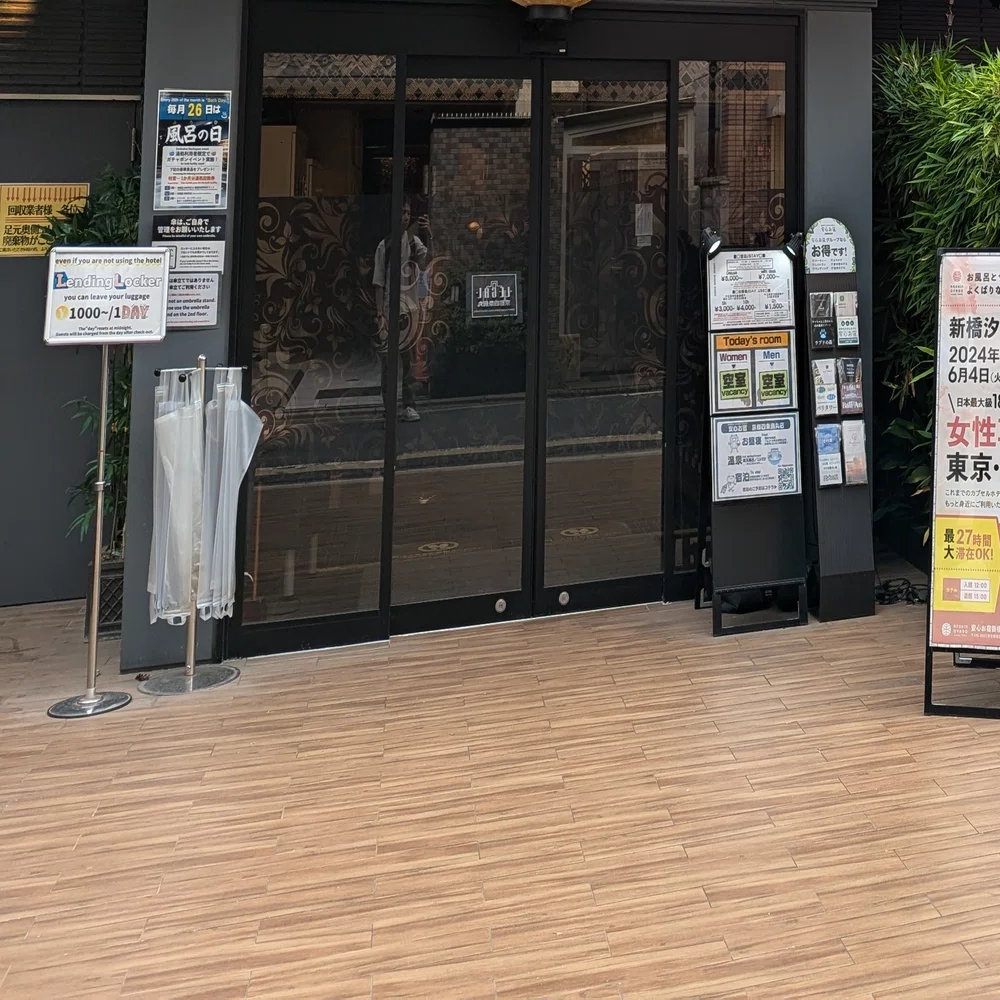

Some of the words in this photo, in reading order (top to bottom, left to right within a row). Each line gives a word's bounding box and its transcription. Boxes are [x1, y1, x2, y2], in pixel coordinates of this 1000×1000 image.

[165, 124, 222, 144] 風呂の日
[8, 204, 53, 216] 回収業者様
[811, 244, 848, 257] お得です!
[78, 258, 90, 266] you
[116, 256, 133, 266] using
[134, 256, 144, 264] the
[145, 256, 162, 264] hotel
[125, 293, 150, 301] luggage
[723, 336, 758, 347] Today's
[760, 335, 782, 344] room
[720, 353, 747, 361] Women
[763, 351, 780, 359] Men
[949, 346, 1000, 363] 2024年
[723, 372, 746, 389] 空室
[762, 373, 785, 390] 空室
[721, 388, 748, 396] vacancy
[761, 388, 788, 397] vacancy
[728, 455, 742, 466] 温泉
[735, 472, 749, 482] 宿泊
